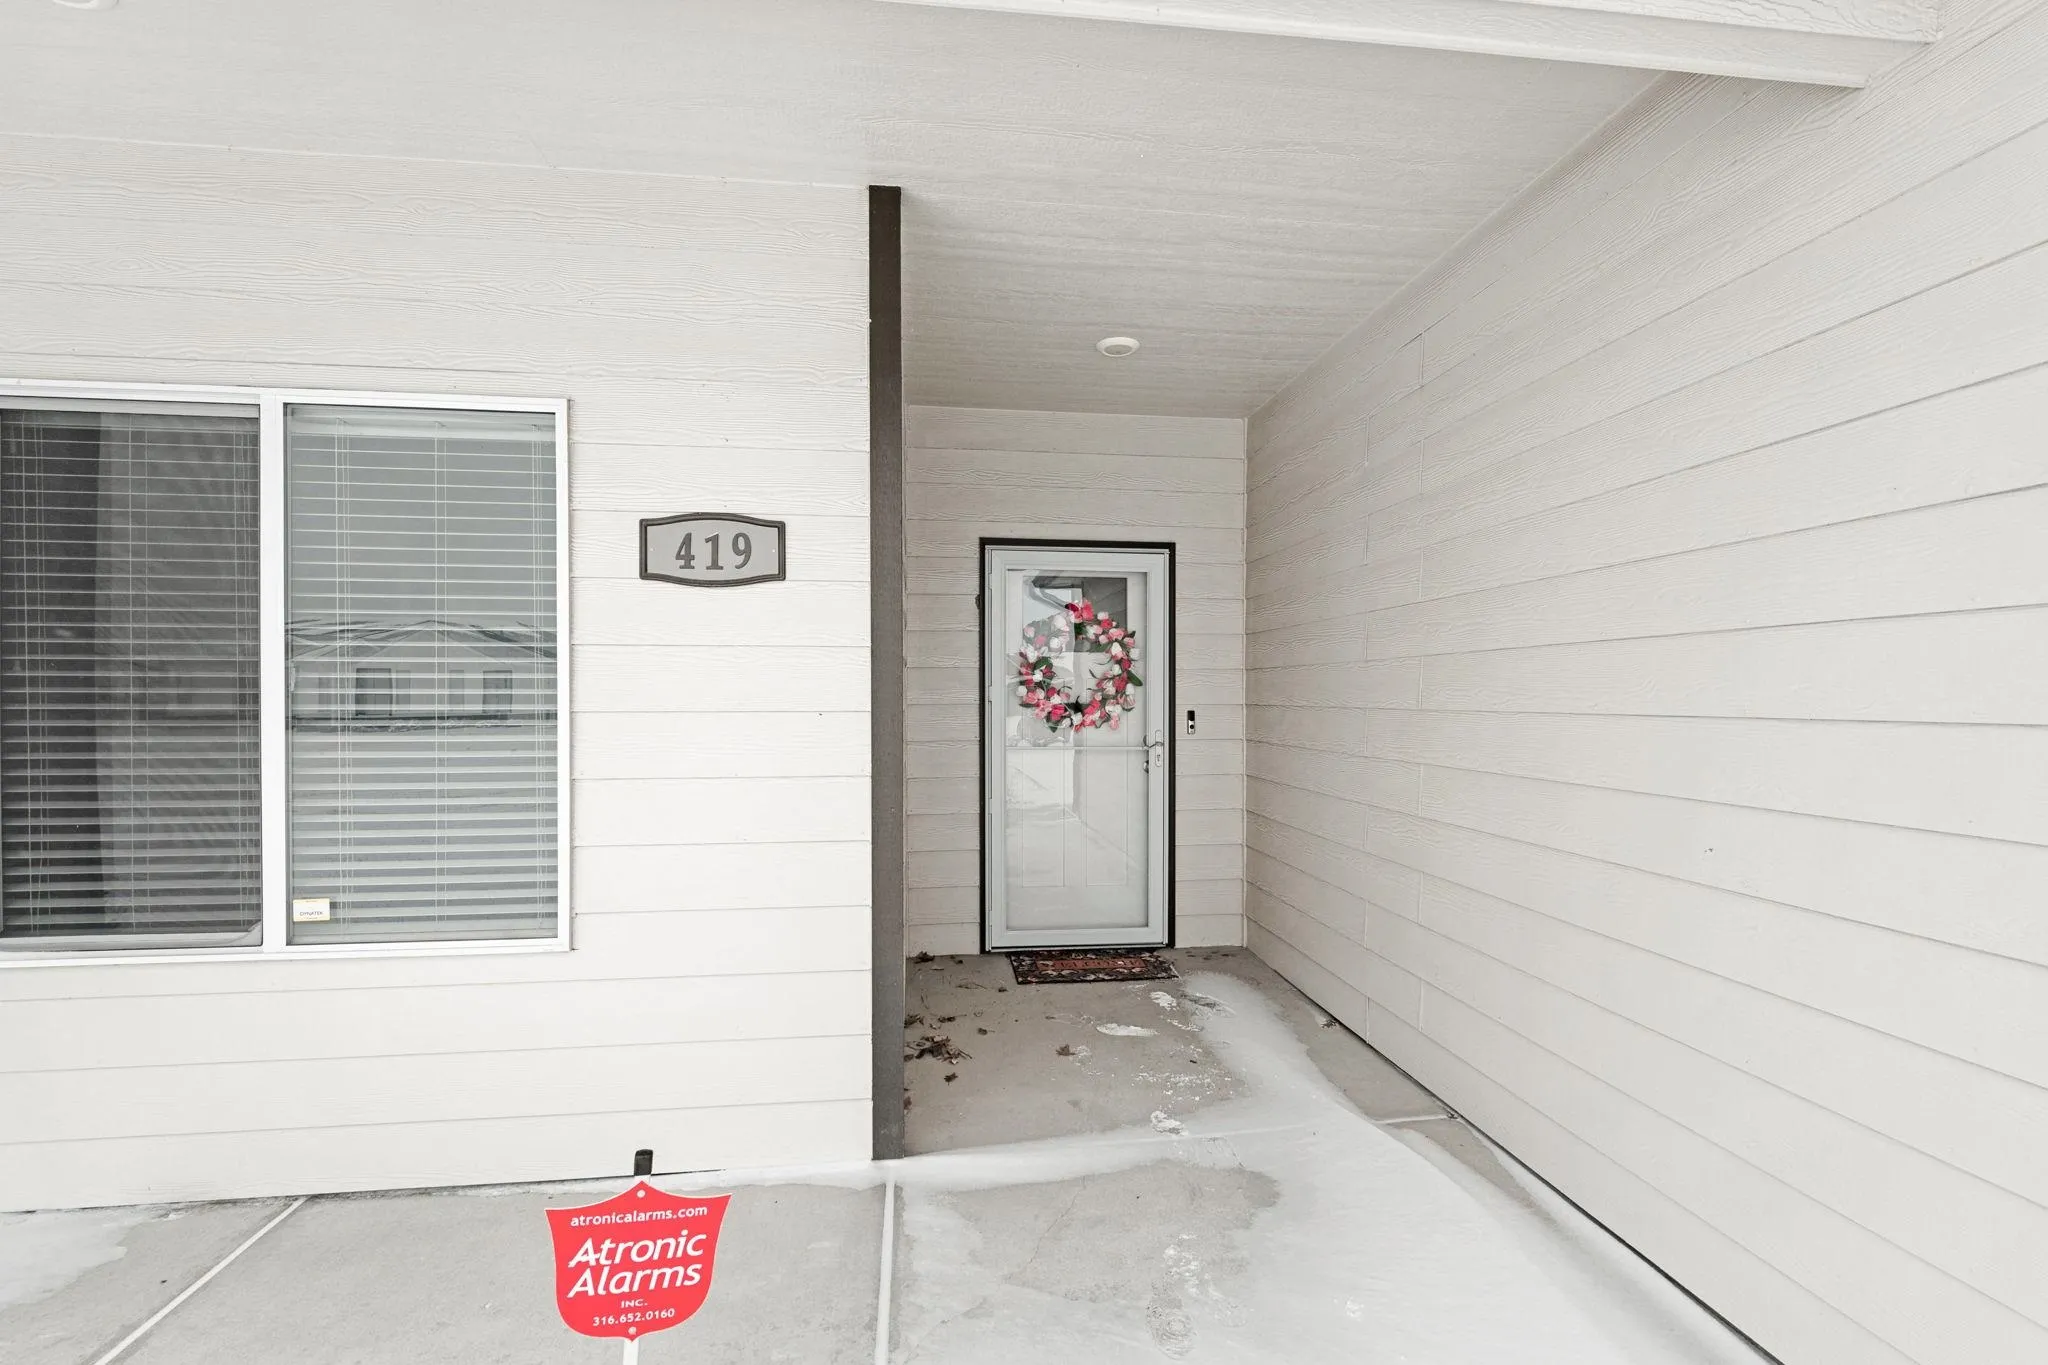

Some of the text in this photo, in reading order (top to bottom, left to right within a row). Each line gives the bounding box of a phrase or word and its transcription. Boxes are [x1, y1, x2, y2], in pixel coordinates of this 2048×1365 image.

[675, 532, 752, 570] 419
[570, 1206, 708, 1226] atronicalarms.com
[567, 1229, 707, 1268] Atronic
[566, 1263, 703, 1298] Alarms
[592, 1308, 675, 1326] 316.652.0160
[620, 1299, 648, 1308] INC.
